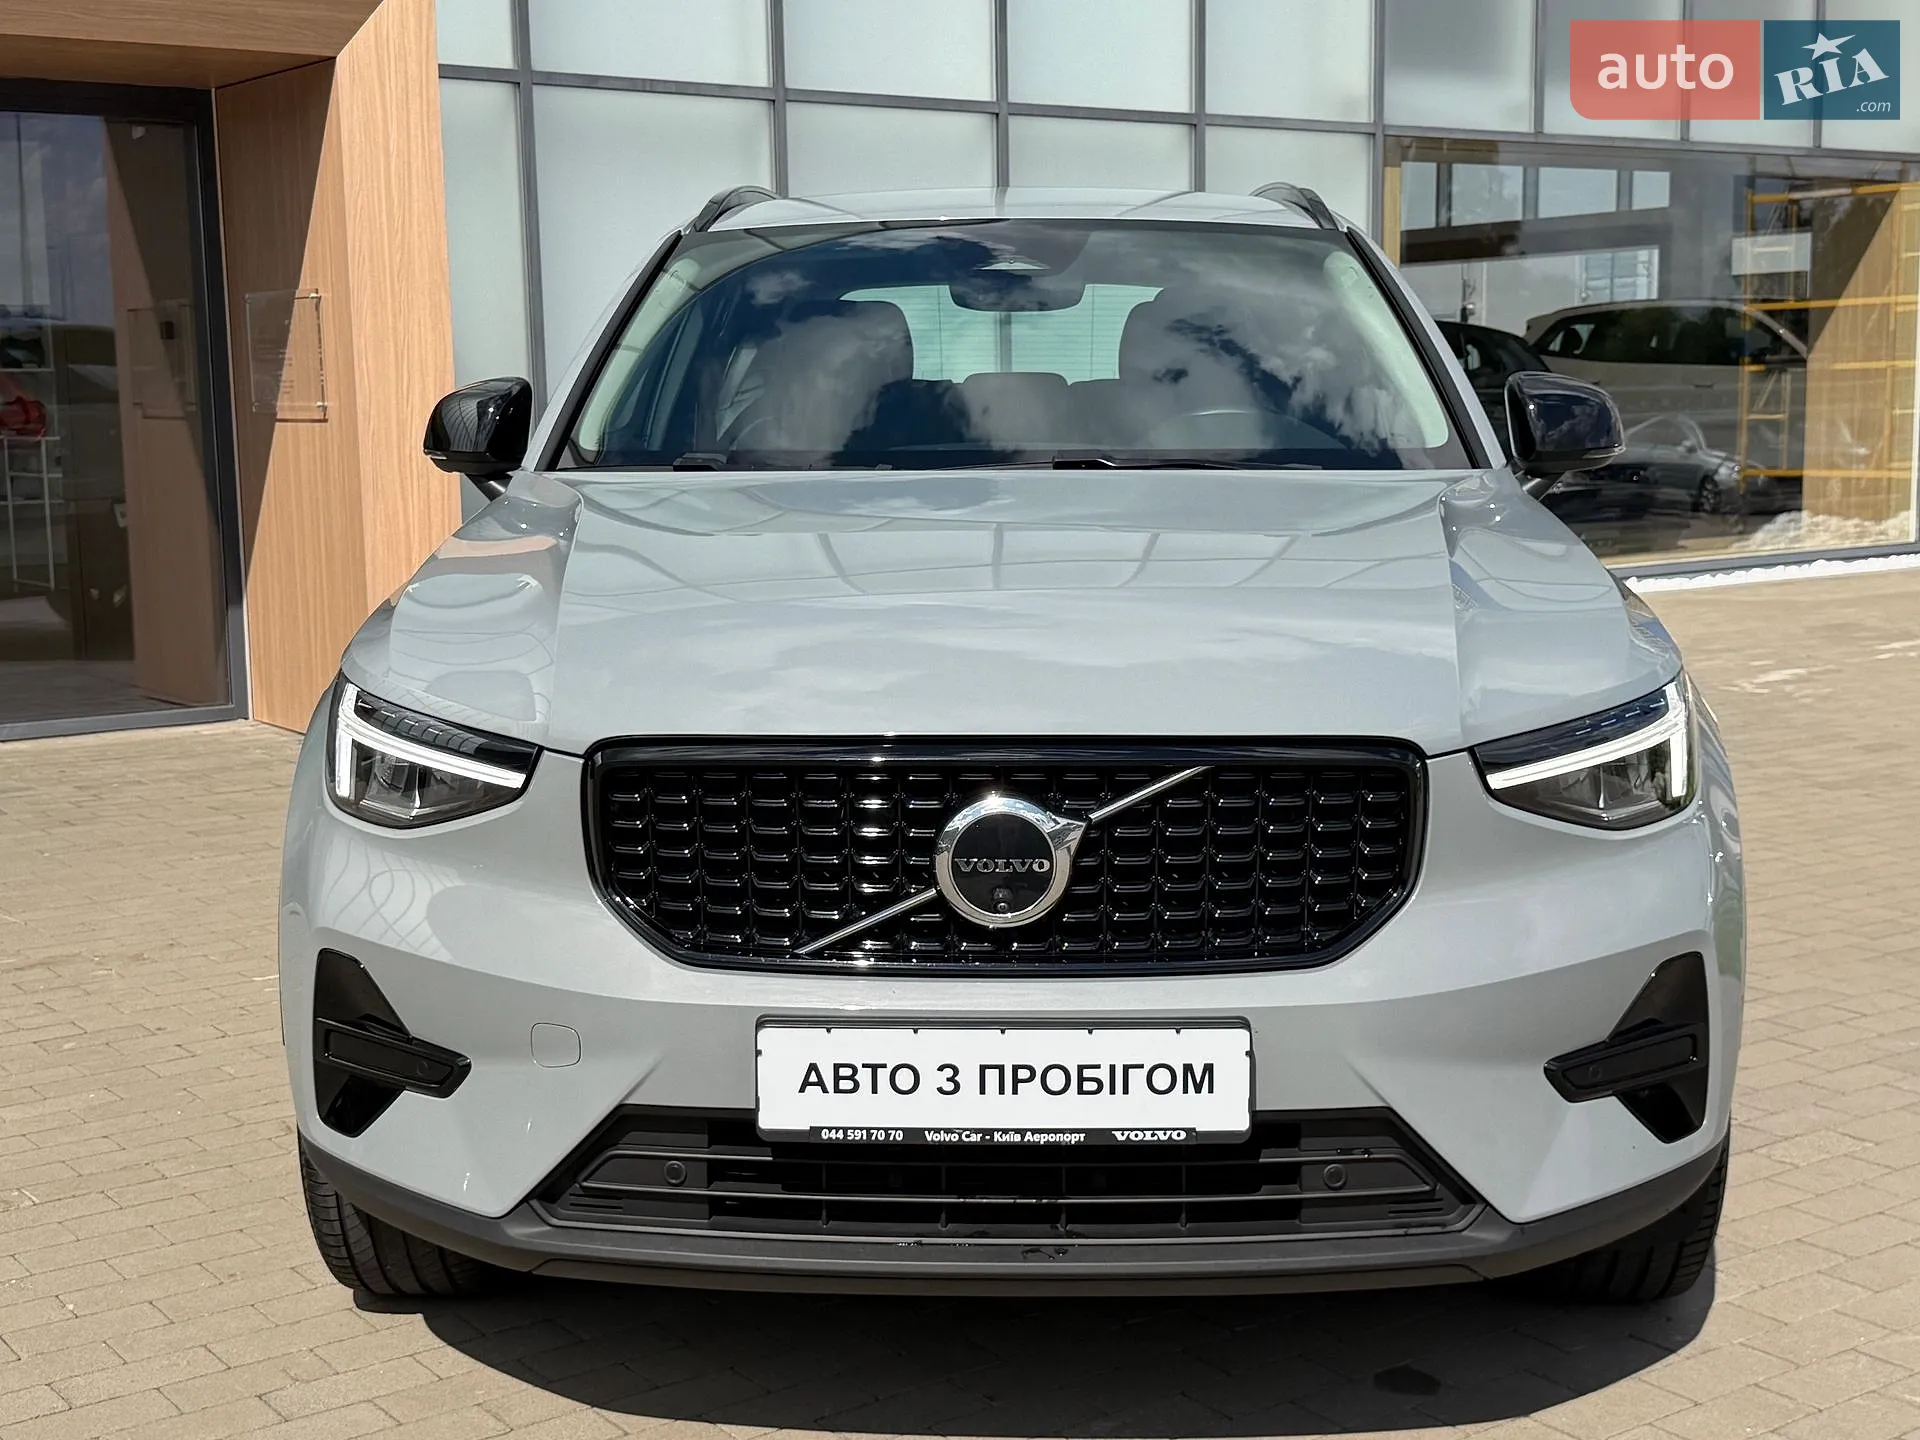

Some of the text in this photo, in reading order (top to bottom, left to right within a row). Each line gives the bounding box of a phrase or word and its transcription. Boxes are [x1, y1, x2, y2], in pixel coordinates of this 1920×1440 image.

[954, 858, 1050, 873] VOLVO
[798, 1062, 921, 1095] АВТО
[978, 1062, 1215, 1096] ПРОБІГОМ
[821, 1128, 844, 1141] 044
[847, 1129, 867, 1141] 591
[870, 1129, 886, 1141] 70
[888, 1129, 904, 1141] 70
[925, 1130, 959, 1142] Volvo
[961, 1131, 983, 1142] Car
[993, 1130, 1021, 1143] Київ
[1024, 1131, 1086, 1145] Аеропорт
[1112, 1130, 1187, 1141] VOLVO
